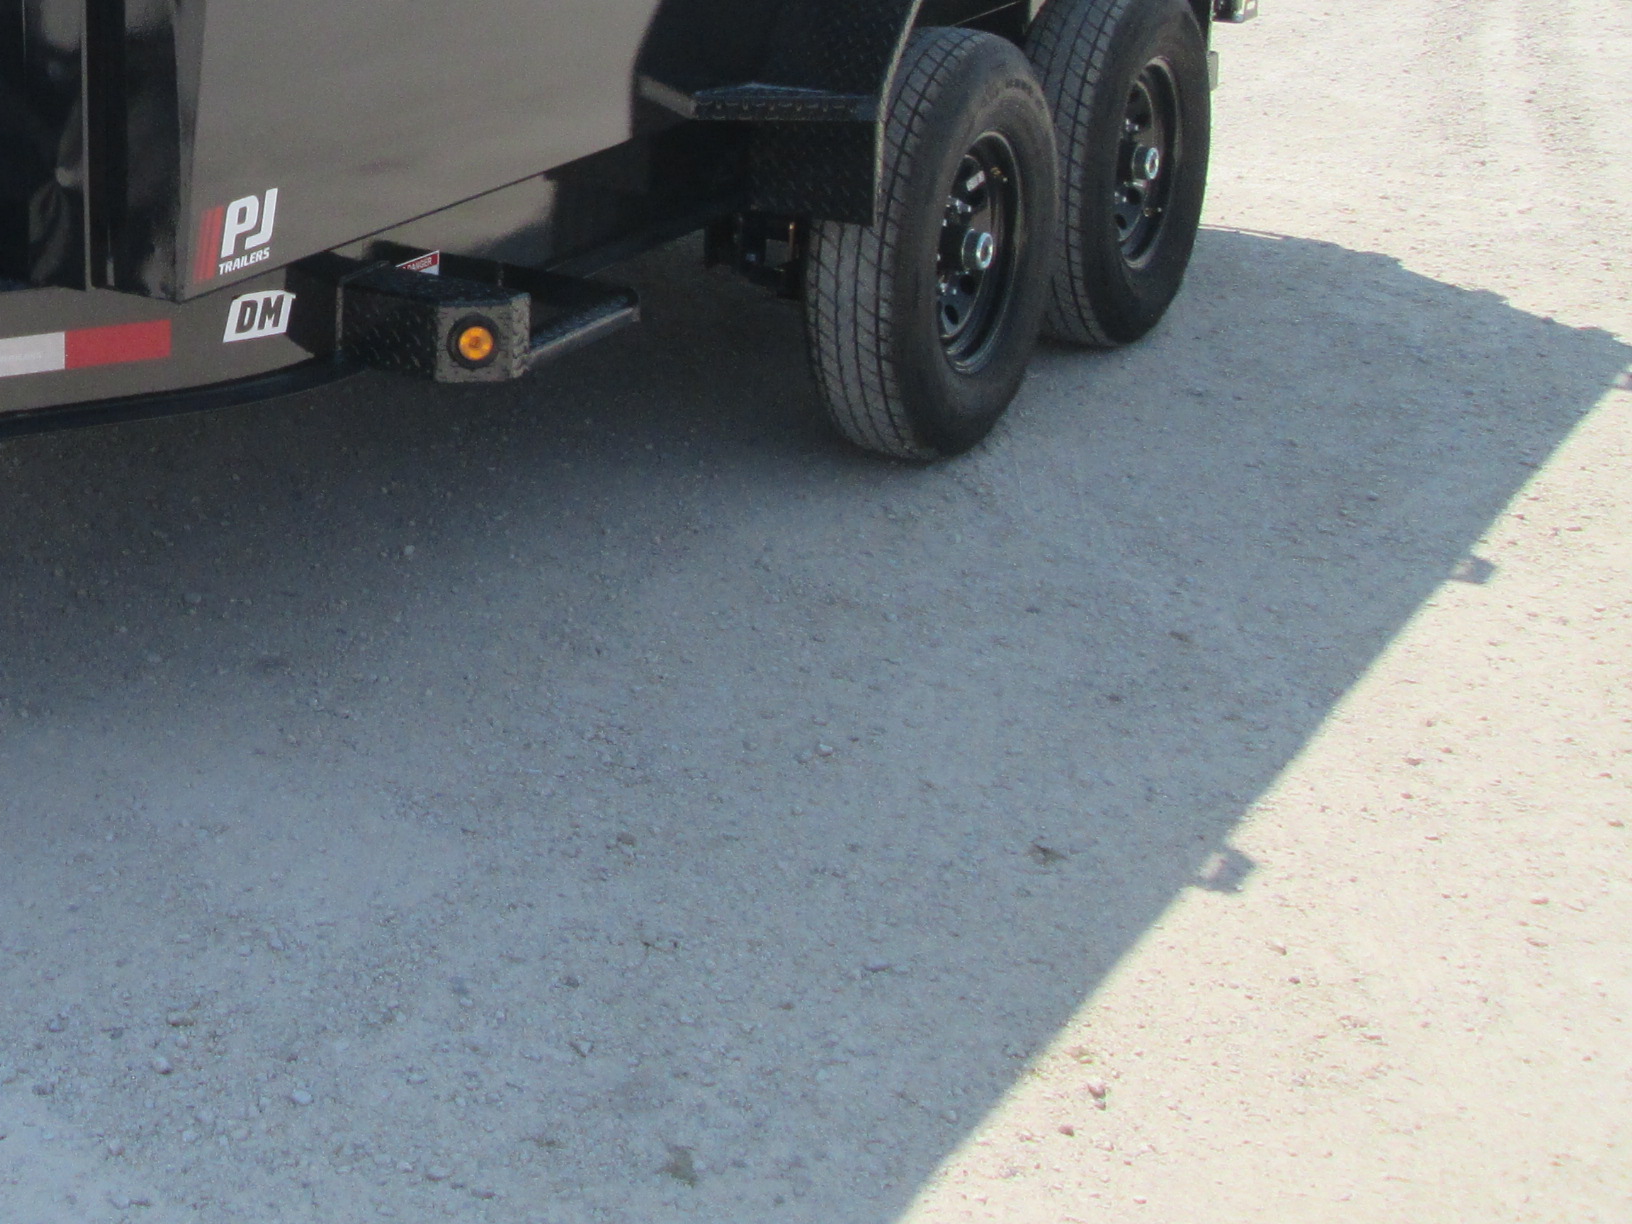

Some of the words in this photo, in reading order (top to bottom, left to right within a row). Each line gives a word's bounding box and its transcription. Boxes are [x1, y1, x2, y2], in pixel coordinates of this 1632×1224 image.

[221, 188, 278, 258] PJ
[219, 247, 270, 275] TRAILERS
[235, 294, 284, 334] DM
